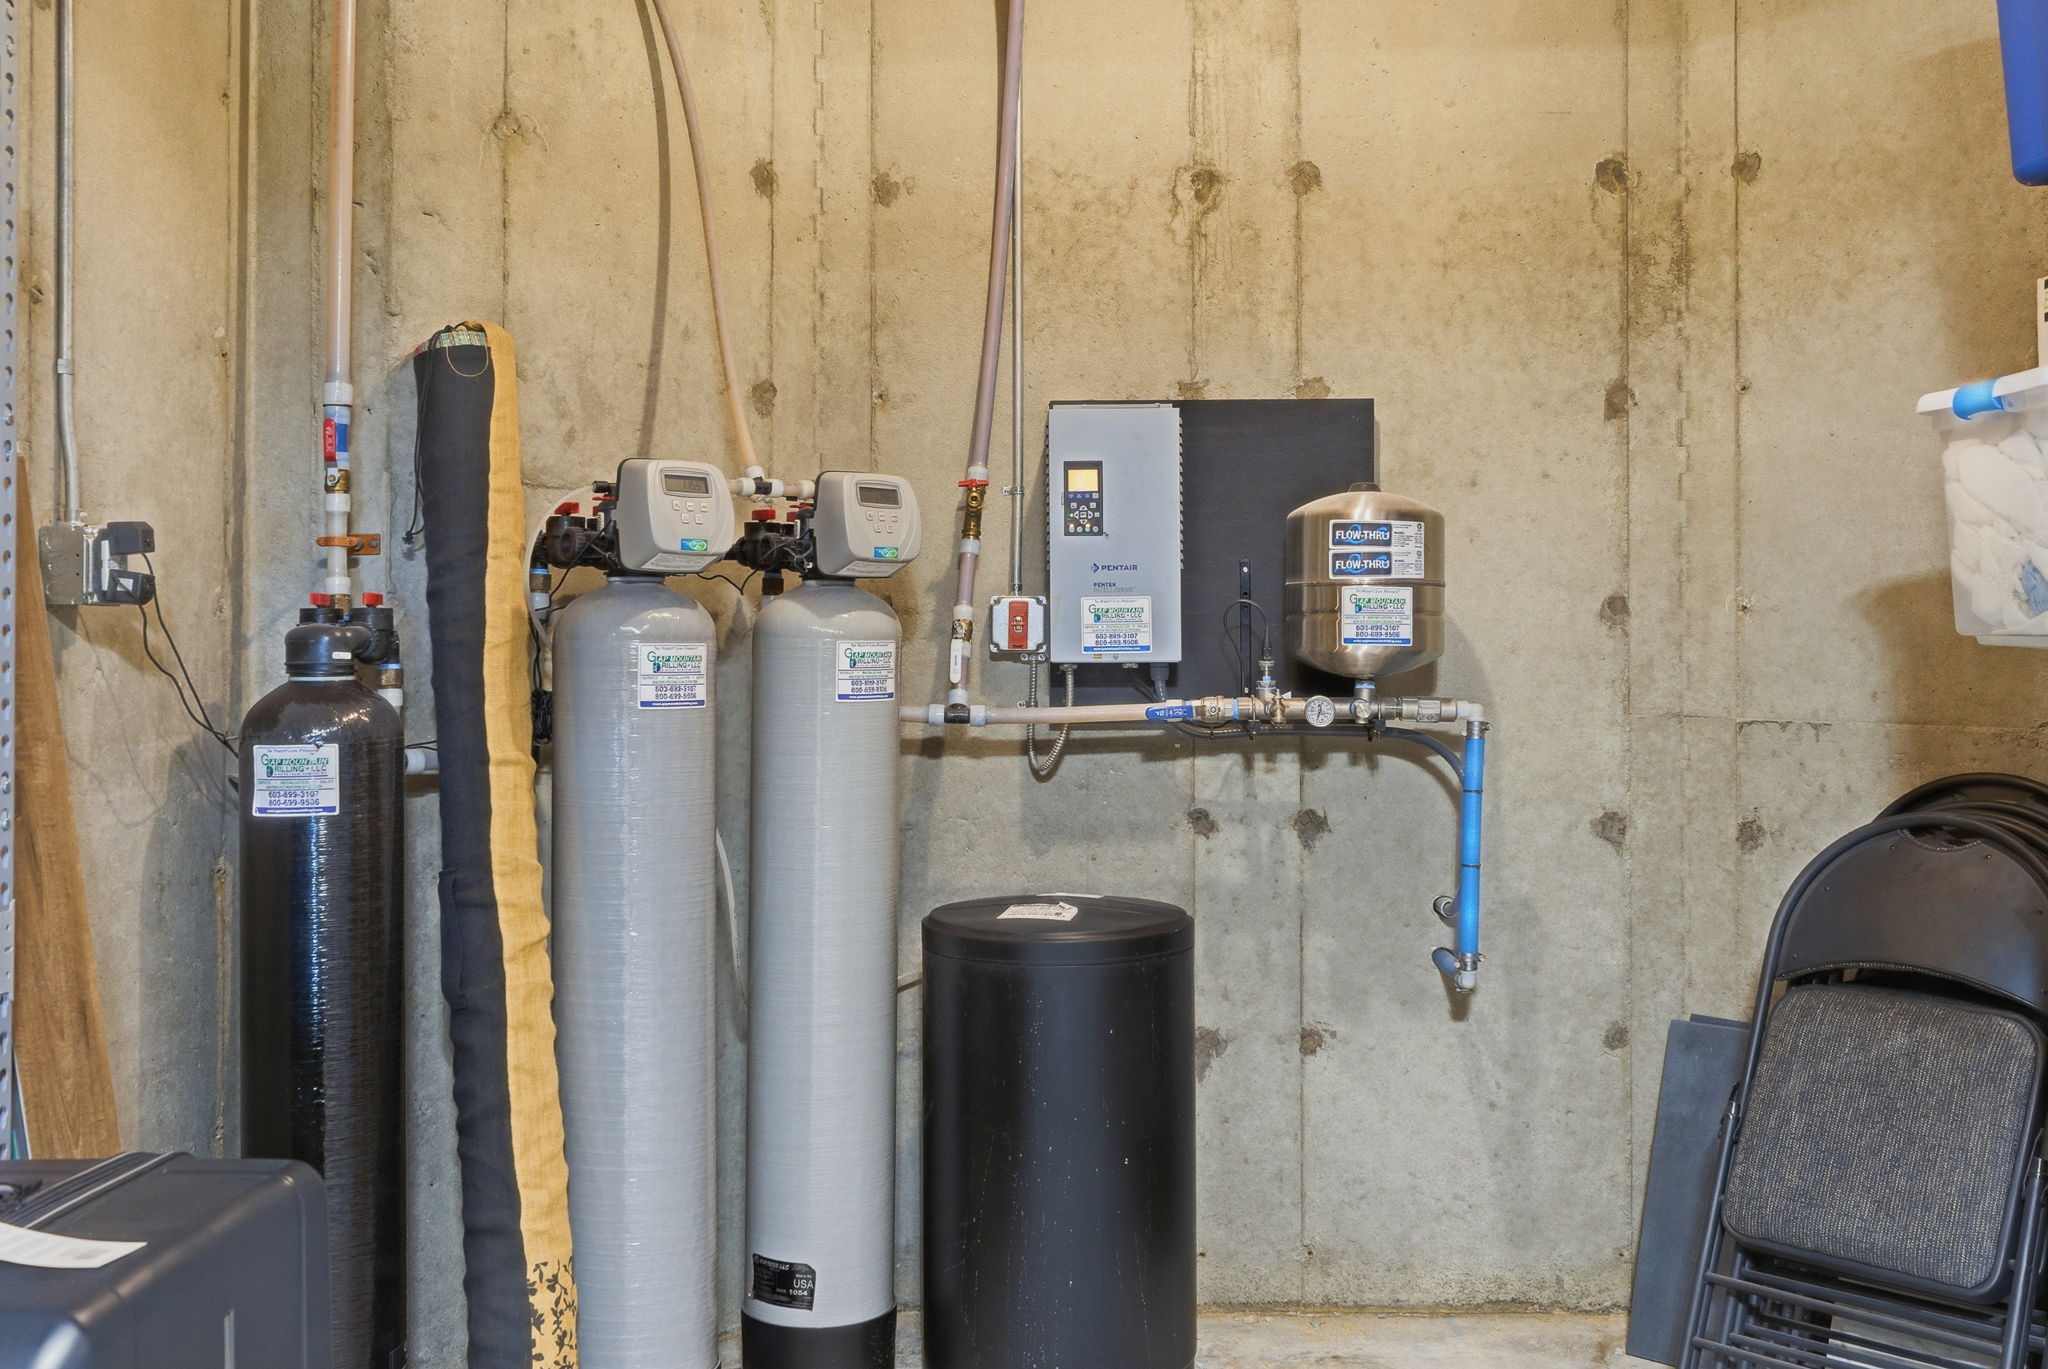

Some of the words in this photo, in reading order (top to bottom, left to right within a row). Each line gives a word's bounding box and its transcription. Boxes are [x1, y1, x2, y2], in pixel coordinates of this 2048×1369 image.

[1335, 530, 1390, 540] FLOW-THRU
[1335, 560, 1390, 569] FLOW-THRU
[793, 1278, 814, 1289] USA
